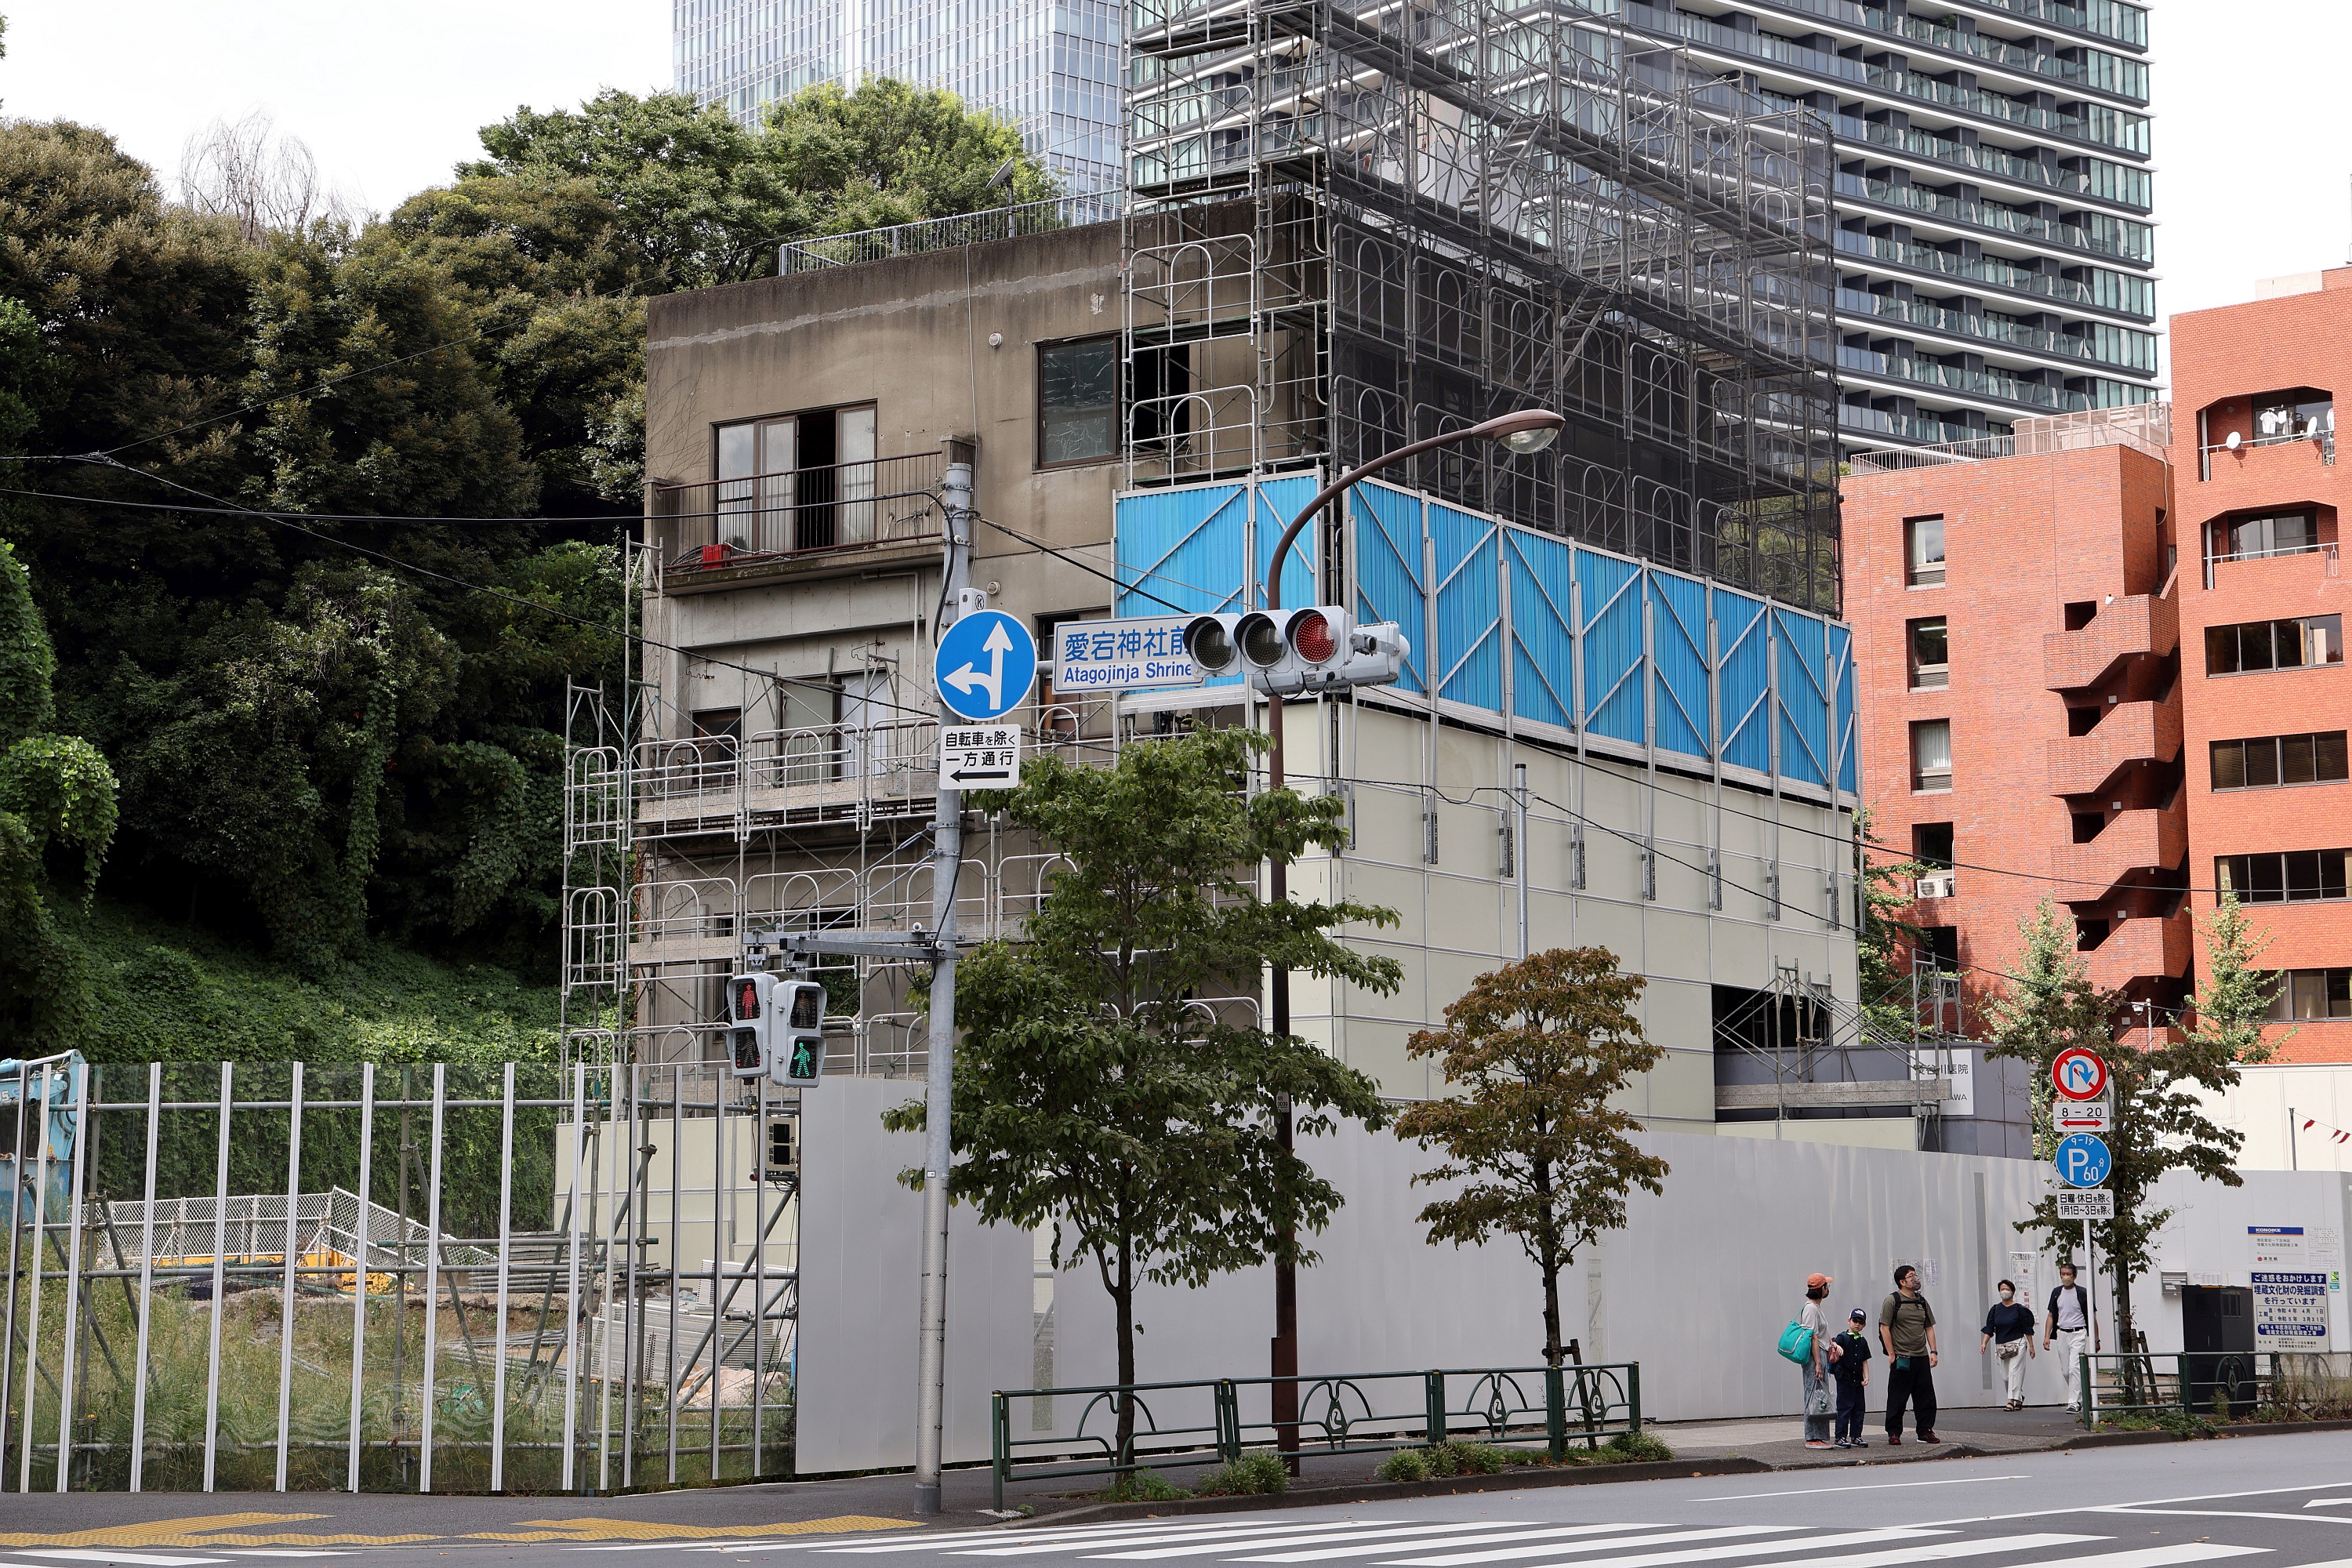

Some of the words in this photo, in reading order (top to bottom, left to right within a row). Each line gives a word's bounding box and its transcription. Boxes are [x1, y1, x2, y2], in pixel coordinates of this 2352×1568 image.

[1065, 625, 1189, 662] 愛宕神社前
[1064, 664, 1139, 684] Atagojinja
[1145, 661, 1192, 679] Shrine
[946, 731, 1015, 747] 自転車を除く
[946, 751, 1014, 767] 一方通行
[2068, 1149, 2089, 1181] P
[2084, 1167, 2099, 1181] 60
[2255, 1274, 2323, 1283] ご迷惑をおかけします
[2254, 1285, 2325, 1296] 埋蔵文化財の発掘調査
